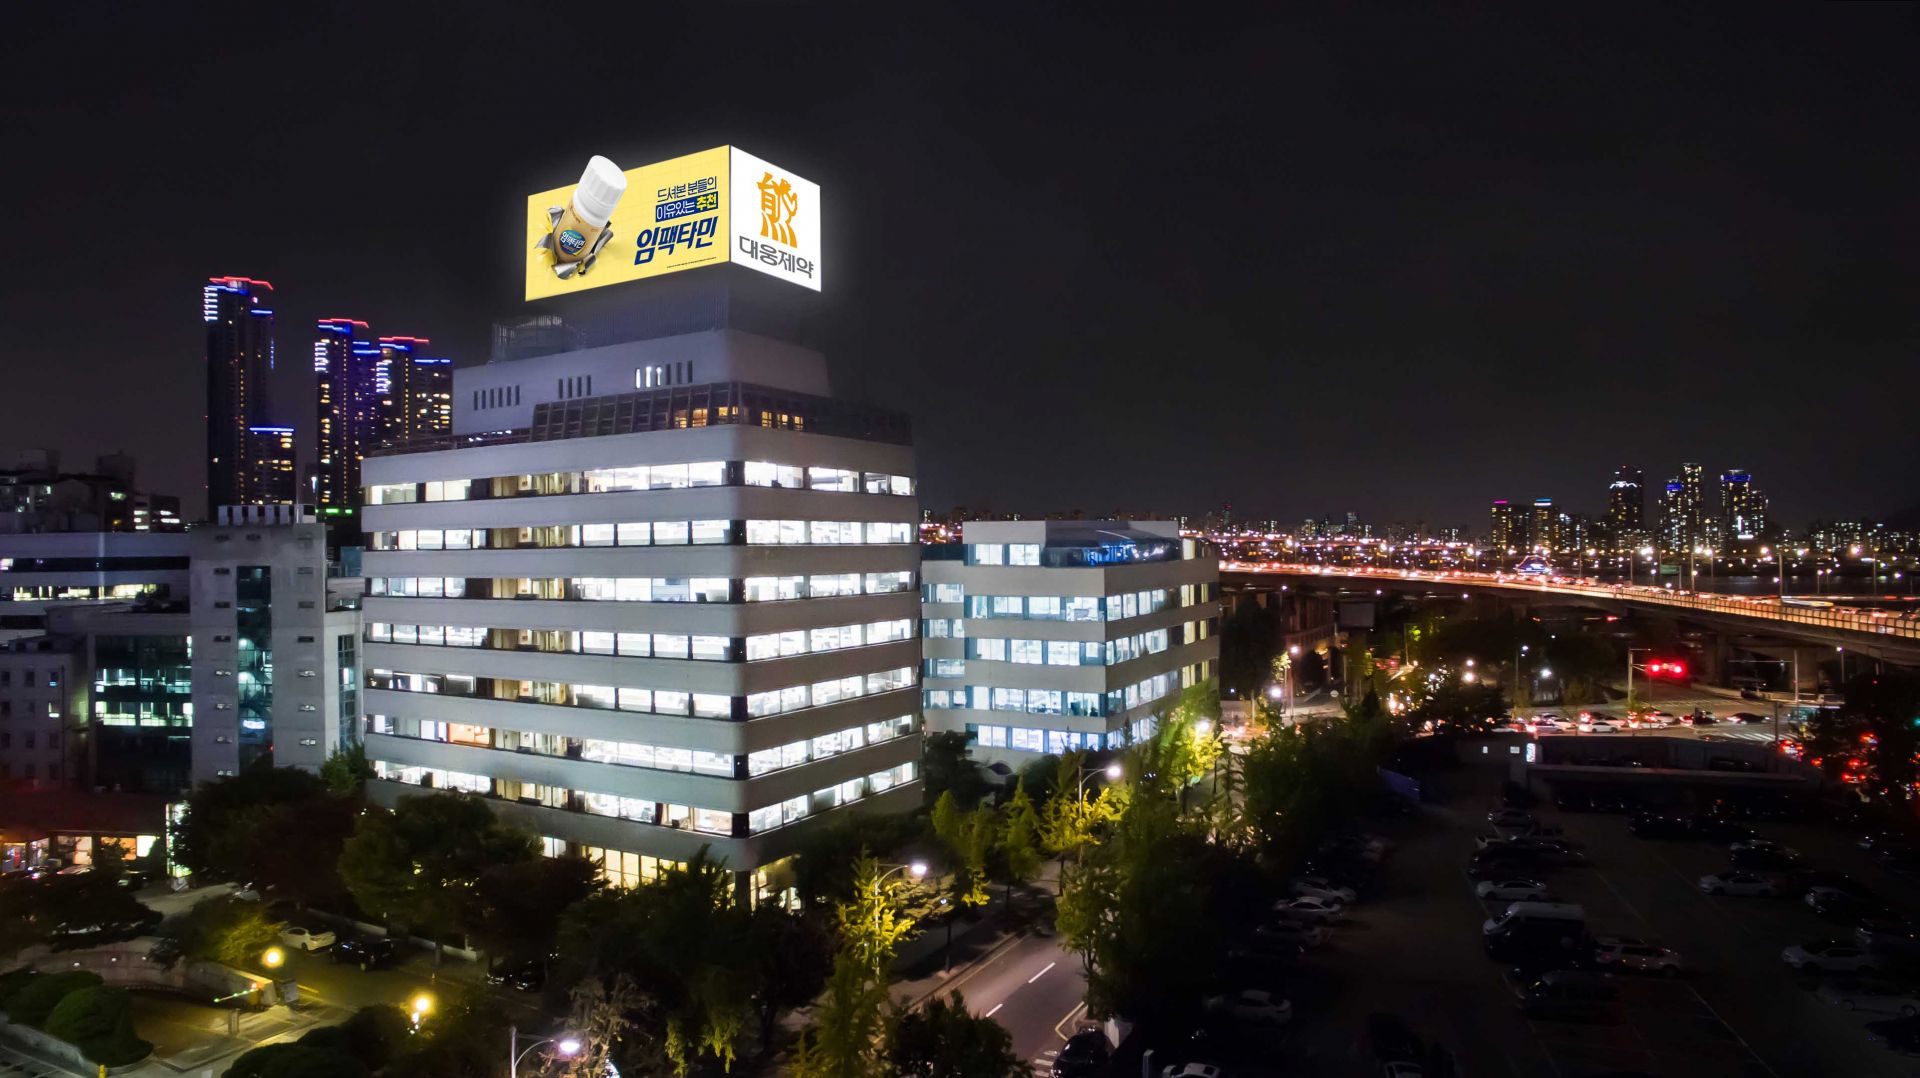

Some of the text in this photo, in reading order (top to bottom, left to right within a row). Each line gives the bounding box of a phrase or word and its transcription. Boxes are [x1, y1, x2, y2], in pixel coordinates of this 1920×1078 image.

[656, 193, 717, 220] 이유있는 추천
[657, 176, 717, 203] 드셔본 분들의
[634, 216, 719, 266] 임팩타민
[739, 235, 815, 279] 대웅제약
